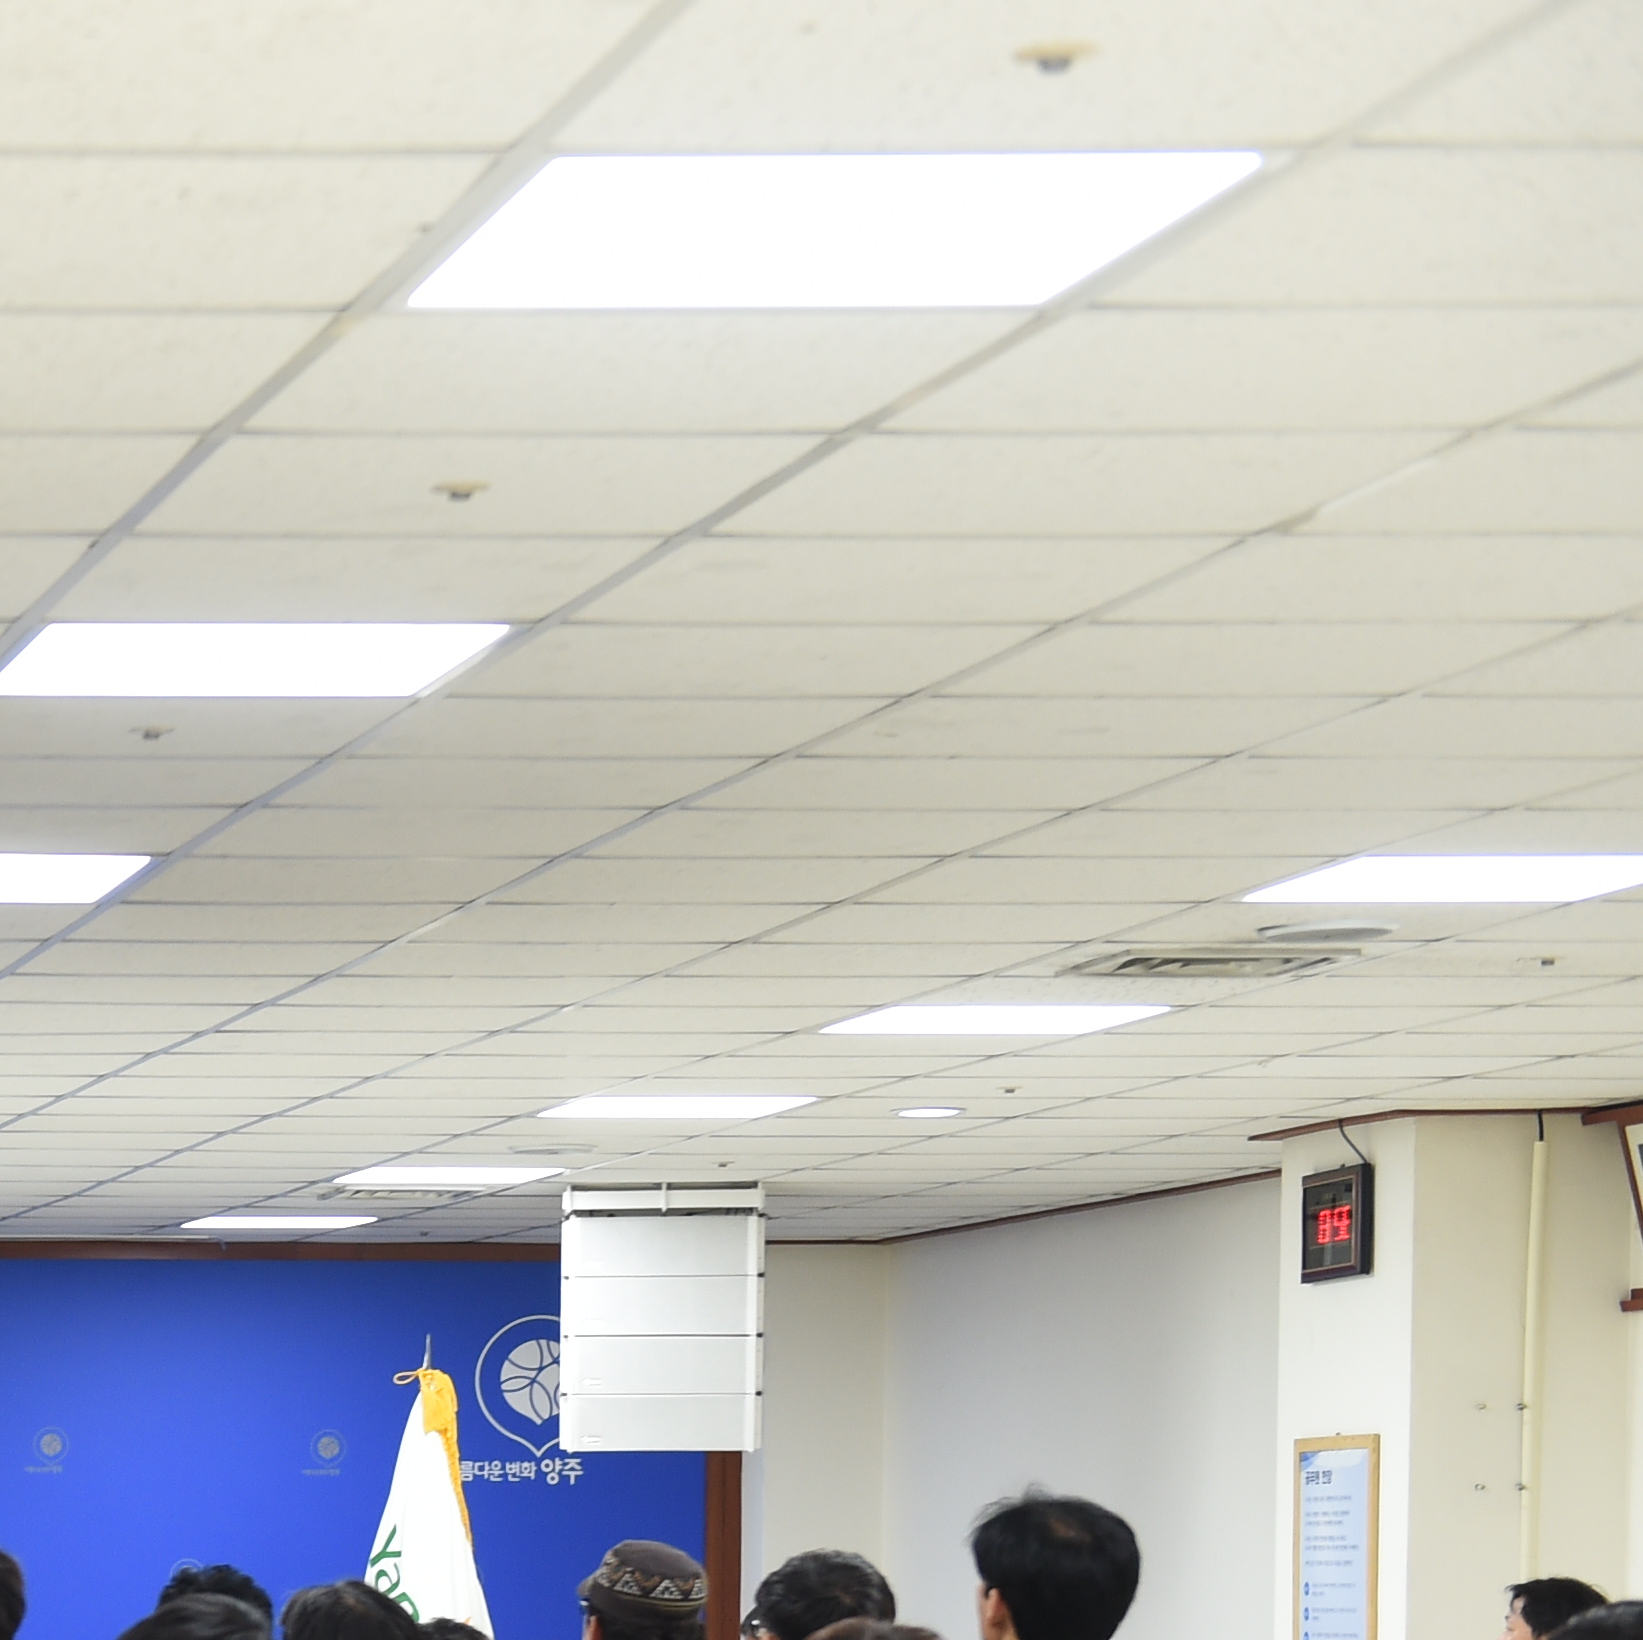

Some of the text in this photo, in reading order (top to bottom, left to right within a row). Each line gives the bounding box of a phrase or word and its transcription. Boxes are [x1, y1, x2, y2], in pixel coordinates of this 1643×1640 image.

[459, 1457, 584, 1485] 름다운 변화 양주
[369, 1523, 420, 1623] Yan
